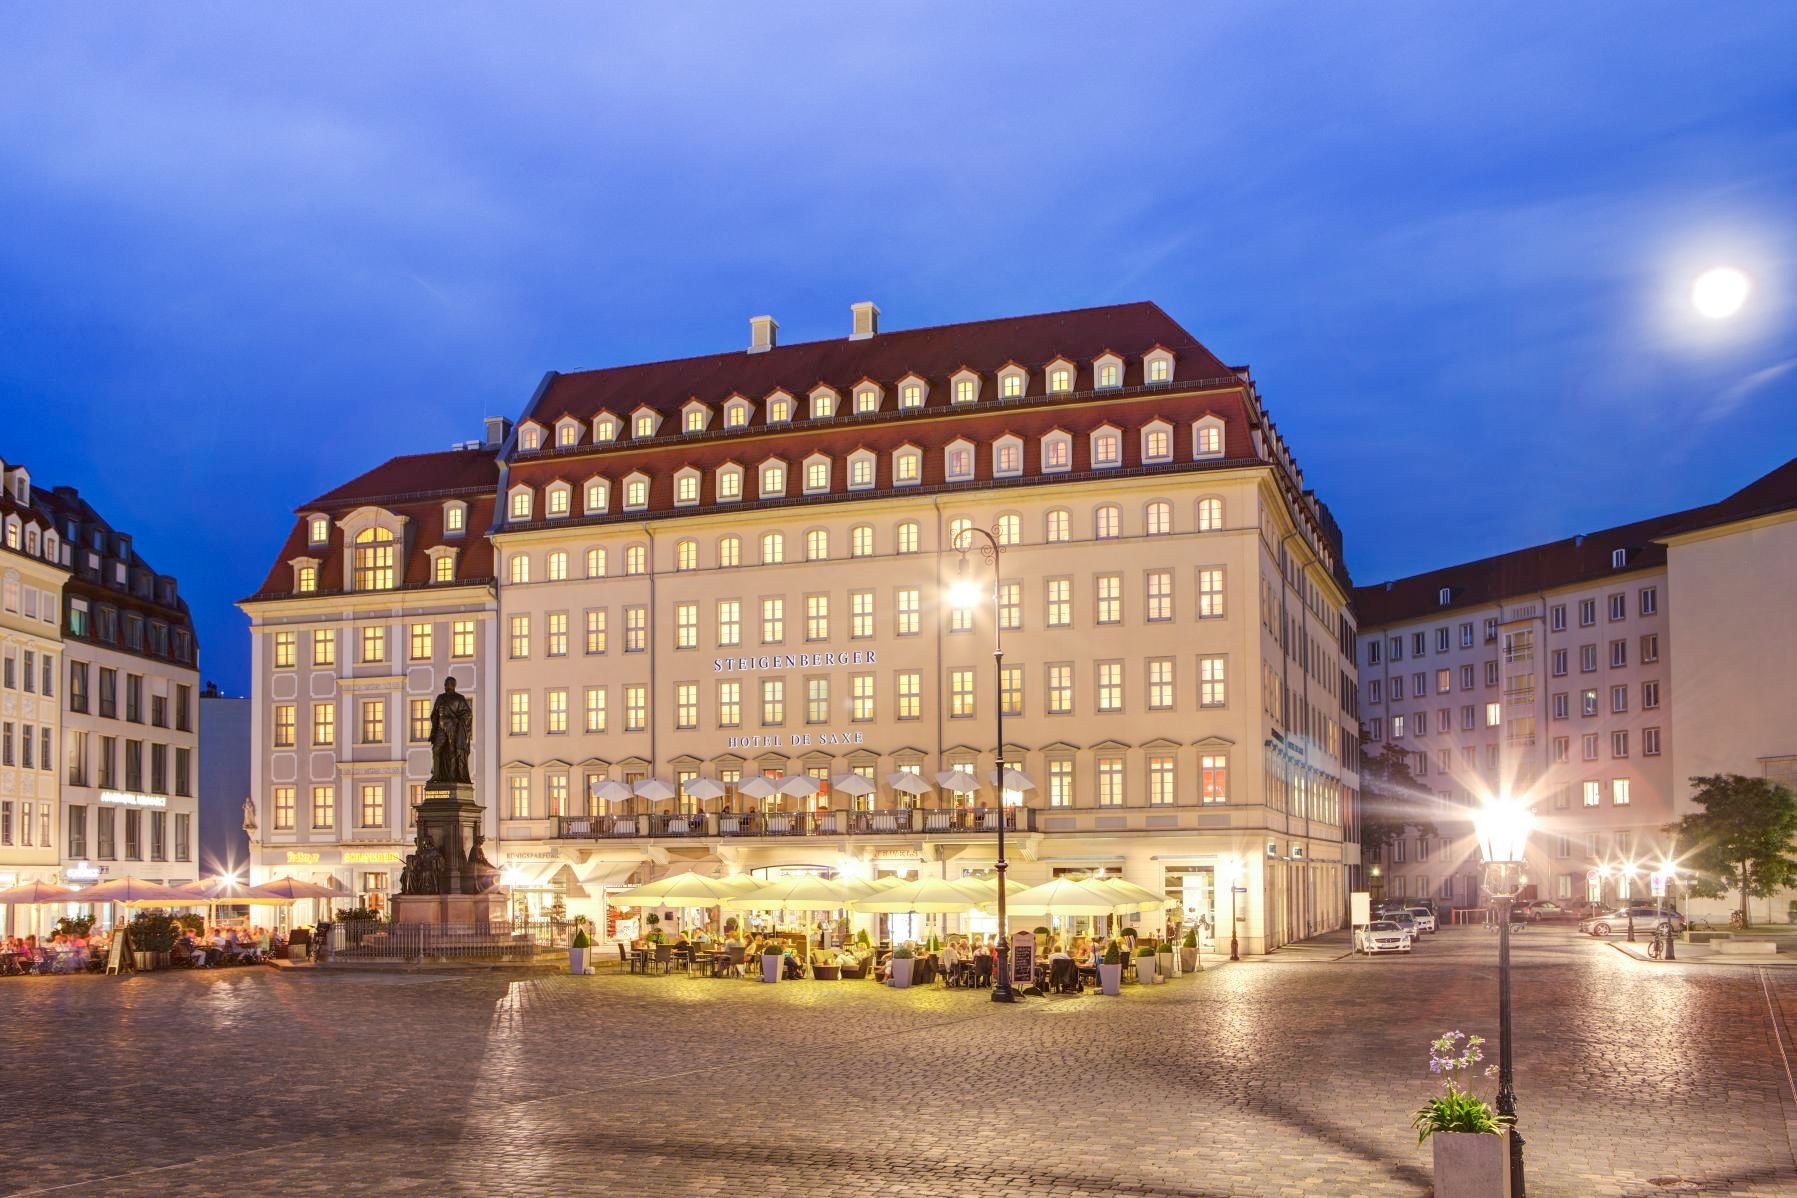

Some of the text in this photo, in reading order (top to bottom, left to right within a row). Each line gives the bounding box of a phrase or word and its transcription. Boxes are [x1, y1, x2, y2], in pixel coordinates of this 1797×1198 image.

[714, 650, 877, 673] STEIGENBERGER
[728, 732, 864, 749] HOTEL DE SAXE
